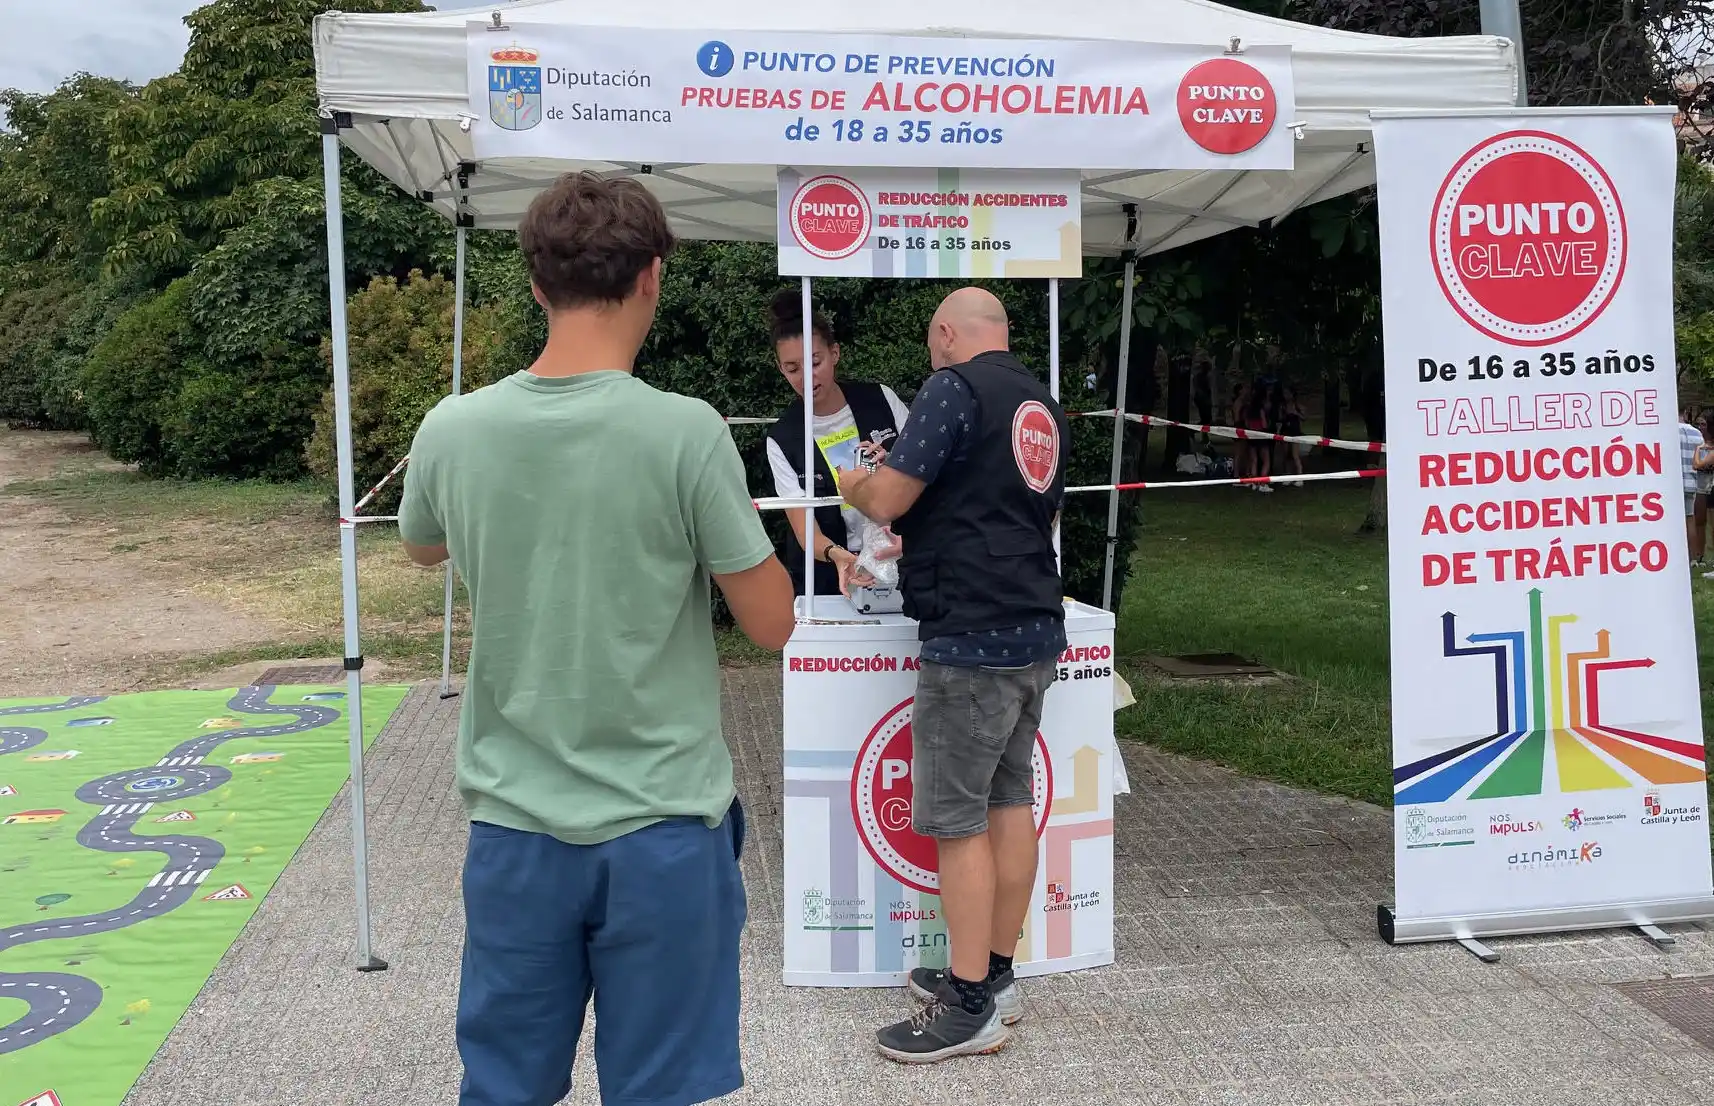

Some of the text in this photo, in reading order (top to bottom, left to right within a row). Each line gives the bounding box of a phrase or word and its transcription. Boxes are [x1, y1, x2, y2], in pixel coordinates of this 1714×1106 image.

[743, 52, 1055, 78] PUNTO DE PREVENCIÓN
[546, 64, 651, 89] Diputación
[681, 82, 1150, 116] PRUEBAS DE ALCOHOLEMIA
[1188, 85, 1266, 101] PUNTO
[546, 103, 672, 123] de Salamanca
[1192, 108, 1264, 125] CLAVE
[785, 116, 1004, 145] de 18 a 35 años
[878, 190, 1068, 208] REDUCCIÓN ACCIDENTES
[801, 202, 859, 217] PUNTO
[801, 219, 860, 234] CLAVE
[878, 212, 969, 229] DE TRÁFICO
[1459, 201, 1596, 236] PUNTO
[878, 236, 1011, 251] De 16 a 35 años
[1459, 241, 1598, 279] CLAVE
[1418, 350, 1655, 382] De 16 a 35 años
[1417, 389, 1660, 436] TALLER DE
[1419, 435, 1662, 488] REDUCCIÓN
[1421, 492, 1664, 536] ACCIDENTES
[1422, 537, 1669, 587] DE TRÁFICO
[789, 653, 897, 672] REDUCCIÓN
[1057, 644, 1111, 664] ÁFICO
[1074, 665, 1111, 680] años
[1427, 814, 1467, 824] Diputación
[1490, 814, 1511, 823] NOS
[1641, 813, 1700, 825] Castilla y León
[1663, 807, 1687, 815] Junta
[1436, 827, 1475, 837] Salamanca
[824, 898, 866, 909] Diputación
[1065, 890, 1100, 902] Junta de
[889, 901, 911, 909] NOS
[1043, 898, 1100, 912] Castilla y León
[834, 911, 874, 920] Salamanca
[890, 910, 936, 922] IMPULS
